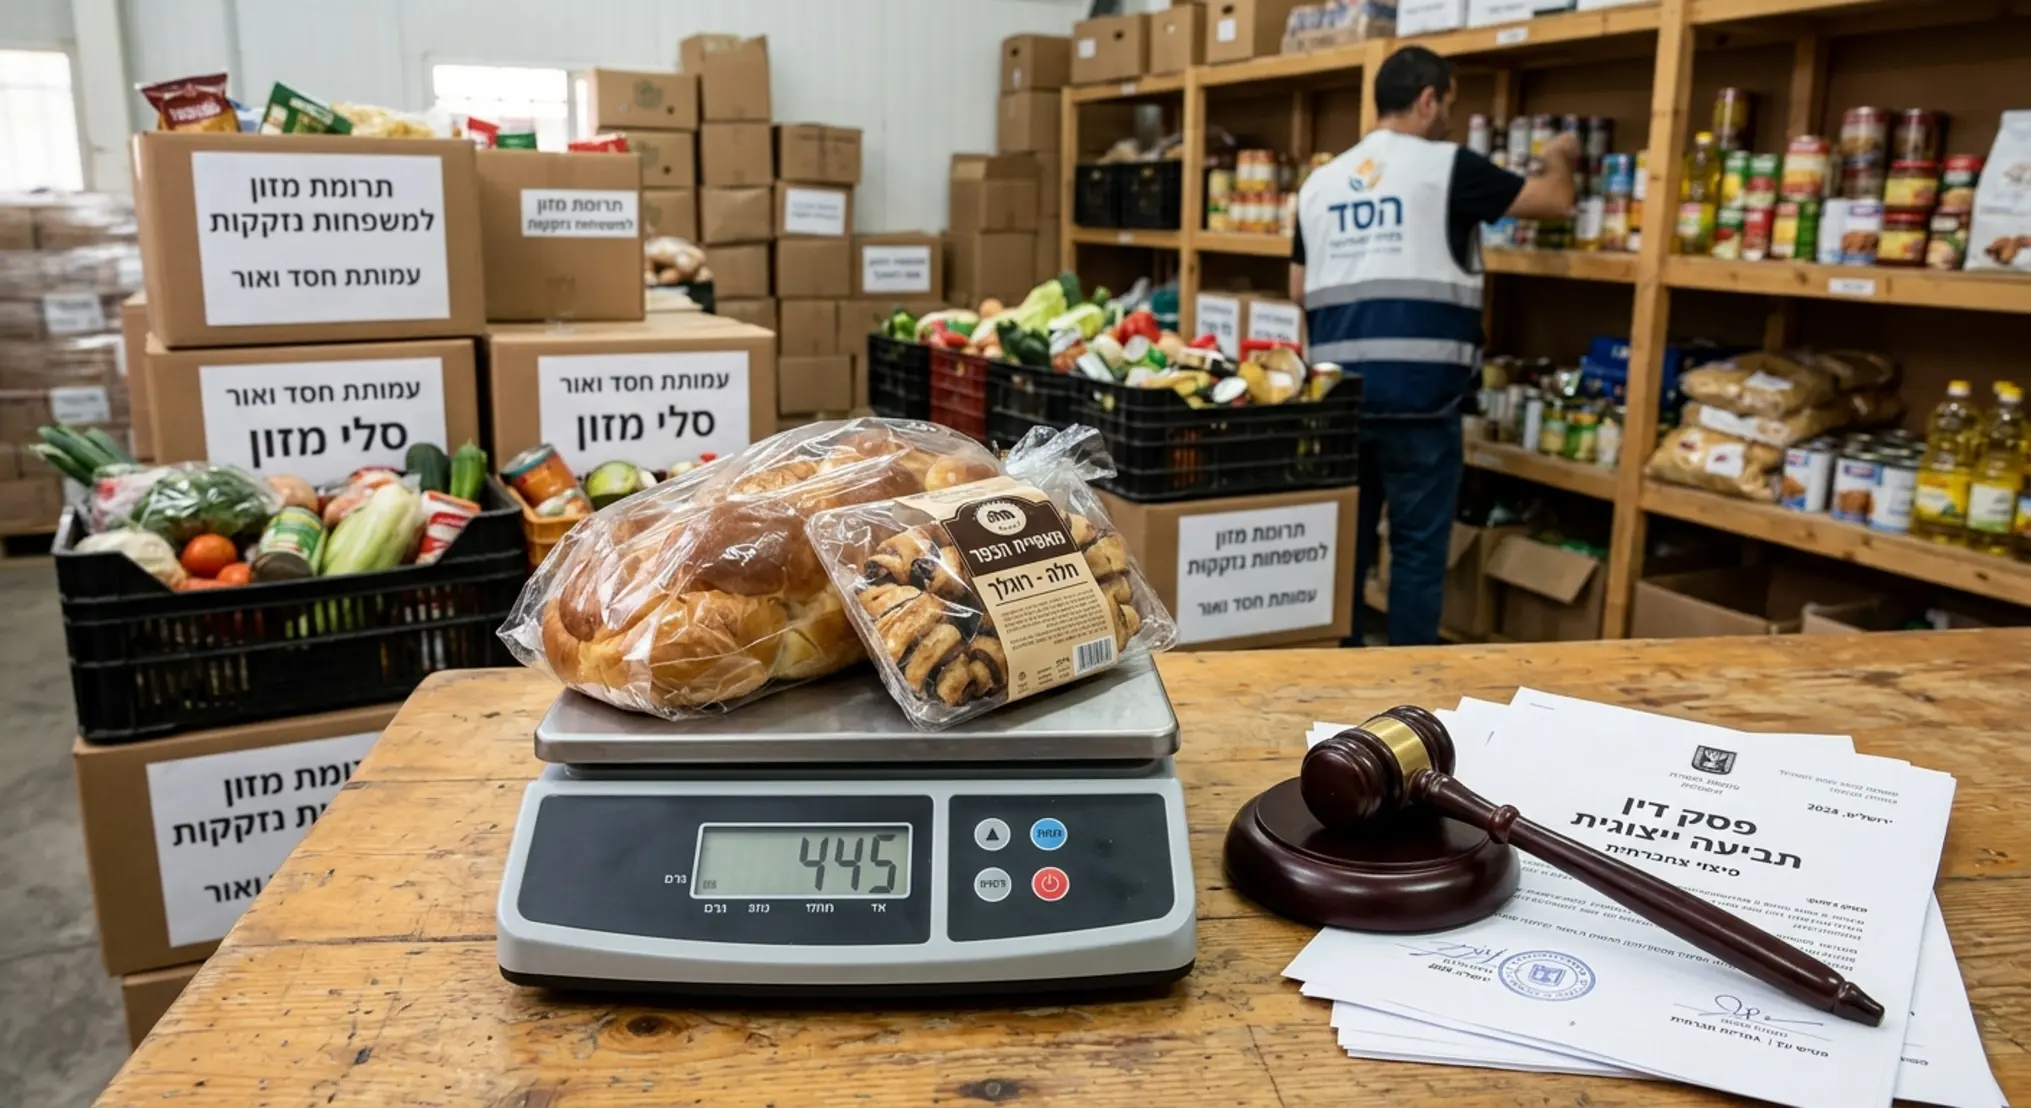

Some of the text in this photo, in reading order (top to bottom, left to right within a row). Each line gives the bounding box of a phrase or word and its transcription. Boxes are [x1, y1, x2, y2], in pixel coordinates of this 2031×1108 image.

[251, 177, 394, 204] תרומת מזון
[210, 208, 435, 239] למשפחות נזקקות
[231, 267, 421, 289] עמותת חסד ואור
[226, 380, 420, 407] עמותת חסד ואור
[560, 372, 729, 394] עמותת חסד ואור
[250, 416, 408, 469] סלי מזון
[577, 405, 715, 451] סלי מזון
[1216, 522, 1306, 551] תרומת מזון
[1047, 561, 1080, 584] חלה
[1187, 542, 1328, 577] למשפחות נזקקות
[987, 575, 1034, 601] רוגלך
[224, 772, 284, 807] מזון
[172, 809, 285, 847] נזקקות
[1621, 797, 1758, 836] פסק דין
[1570, 811, 1802, 870] תביעה ייצוגית
[799, 834, 897, 894] 445
[204, 877, 262, 903] ואור
